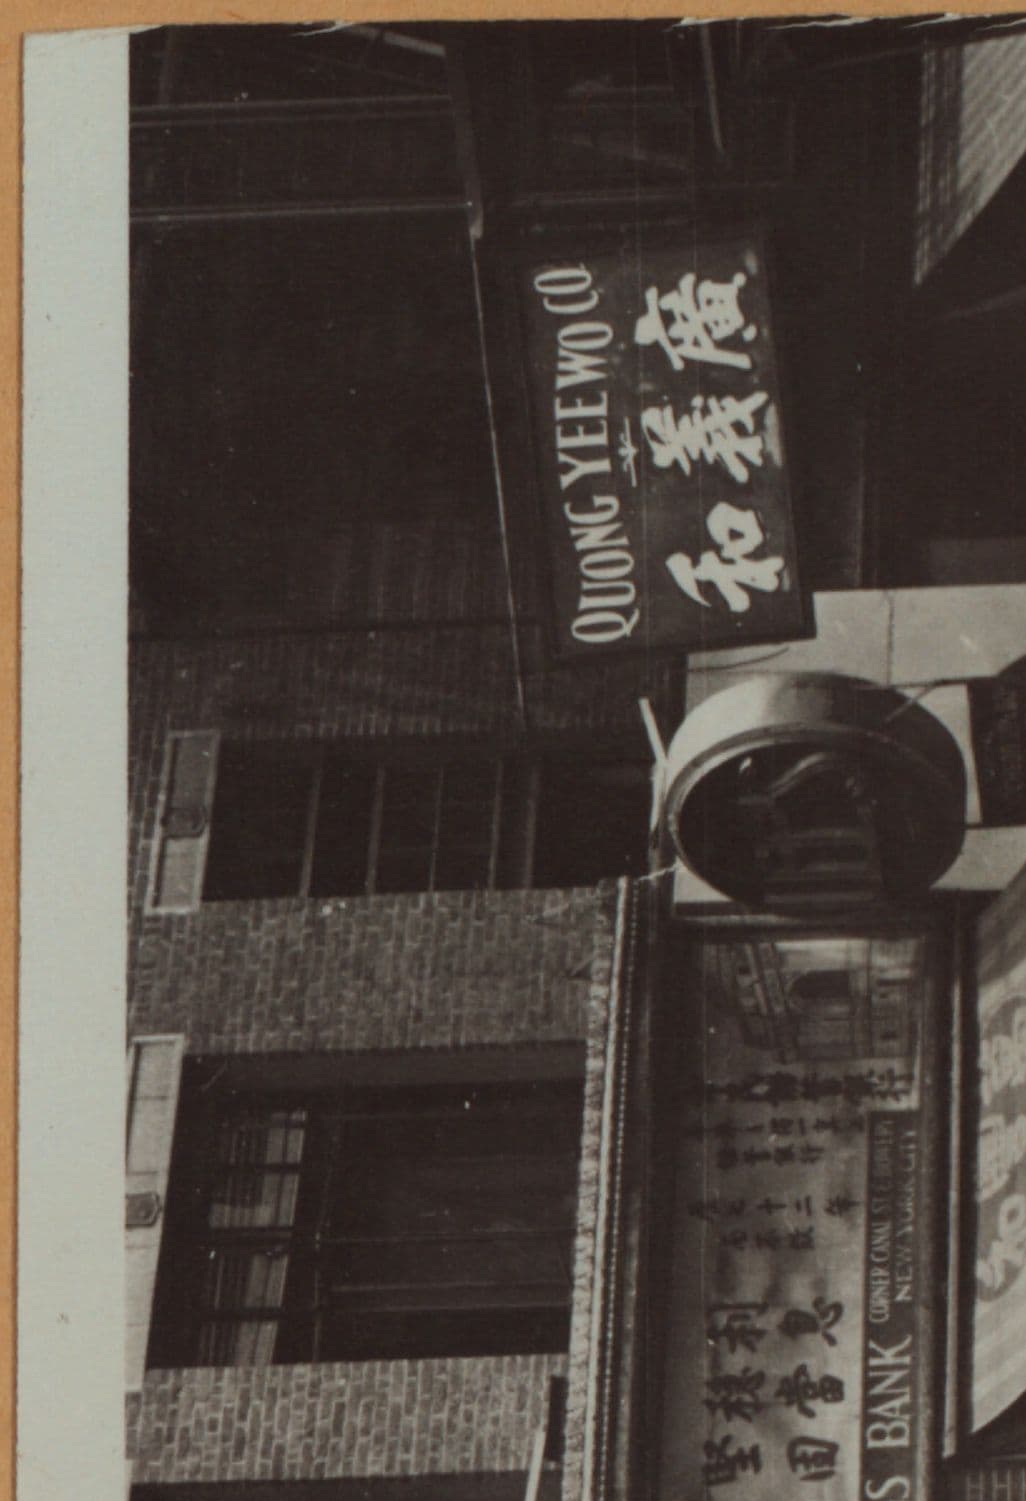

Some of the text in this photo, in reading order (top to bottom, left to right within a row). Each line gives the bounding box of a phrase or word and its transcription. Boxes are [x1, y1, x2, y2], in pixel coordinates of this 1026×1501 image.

[531, 265, 640, 644] QUONG YEE WO CO
[869, 1220, 892, 1264] CANAL
[868, 1266, 891, 1324] CORNER
[893, 1244, 915, 1303] NEW
[865, 1333, 915, 1449] BANK
